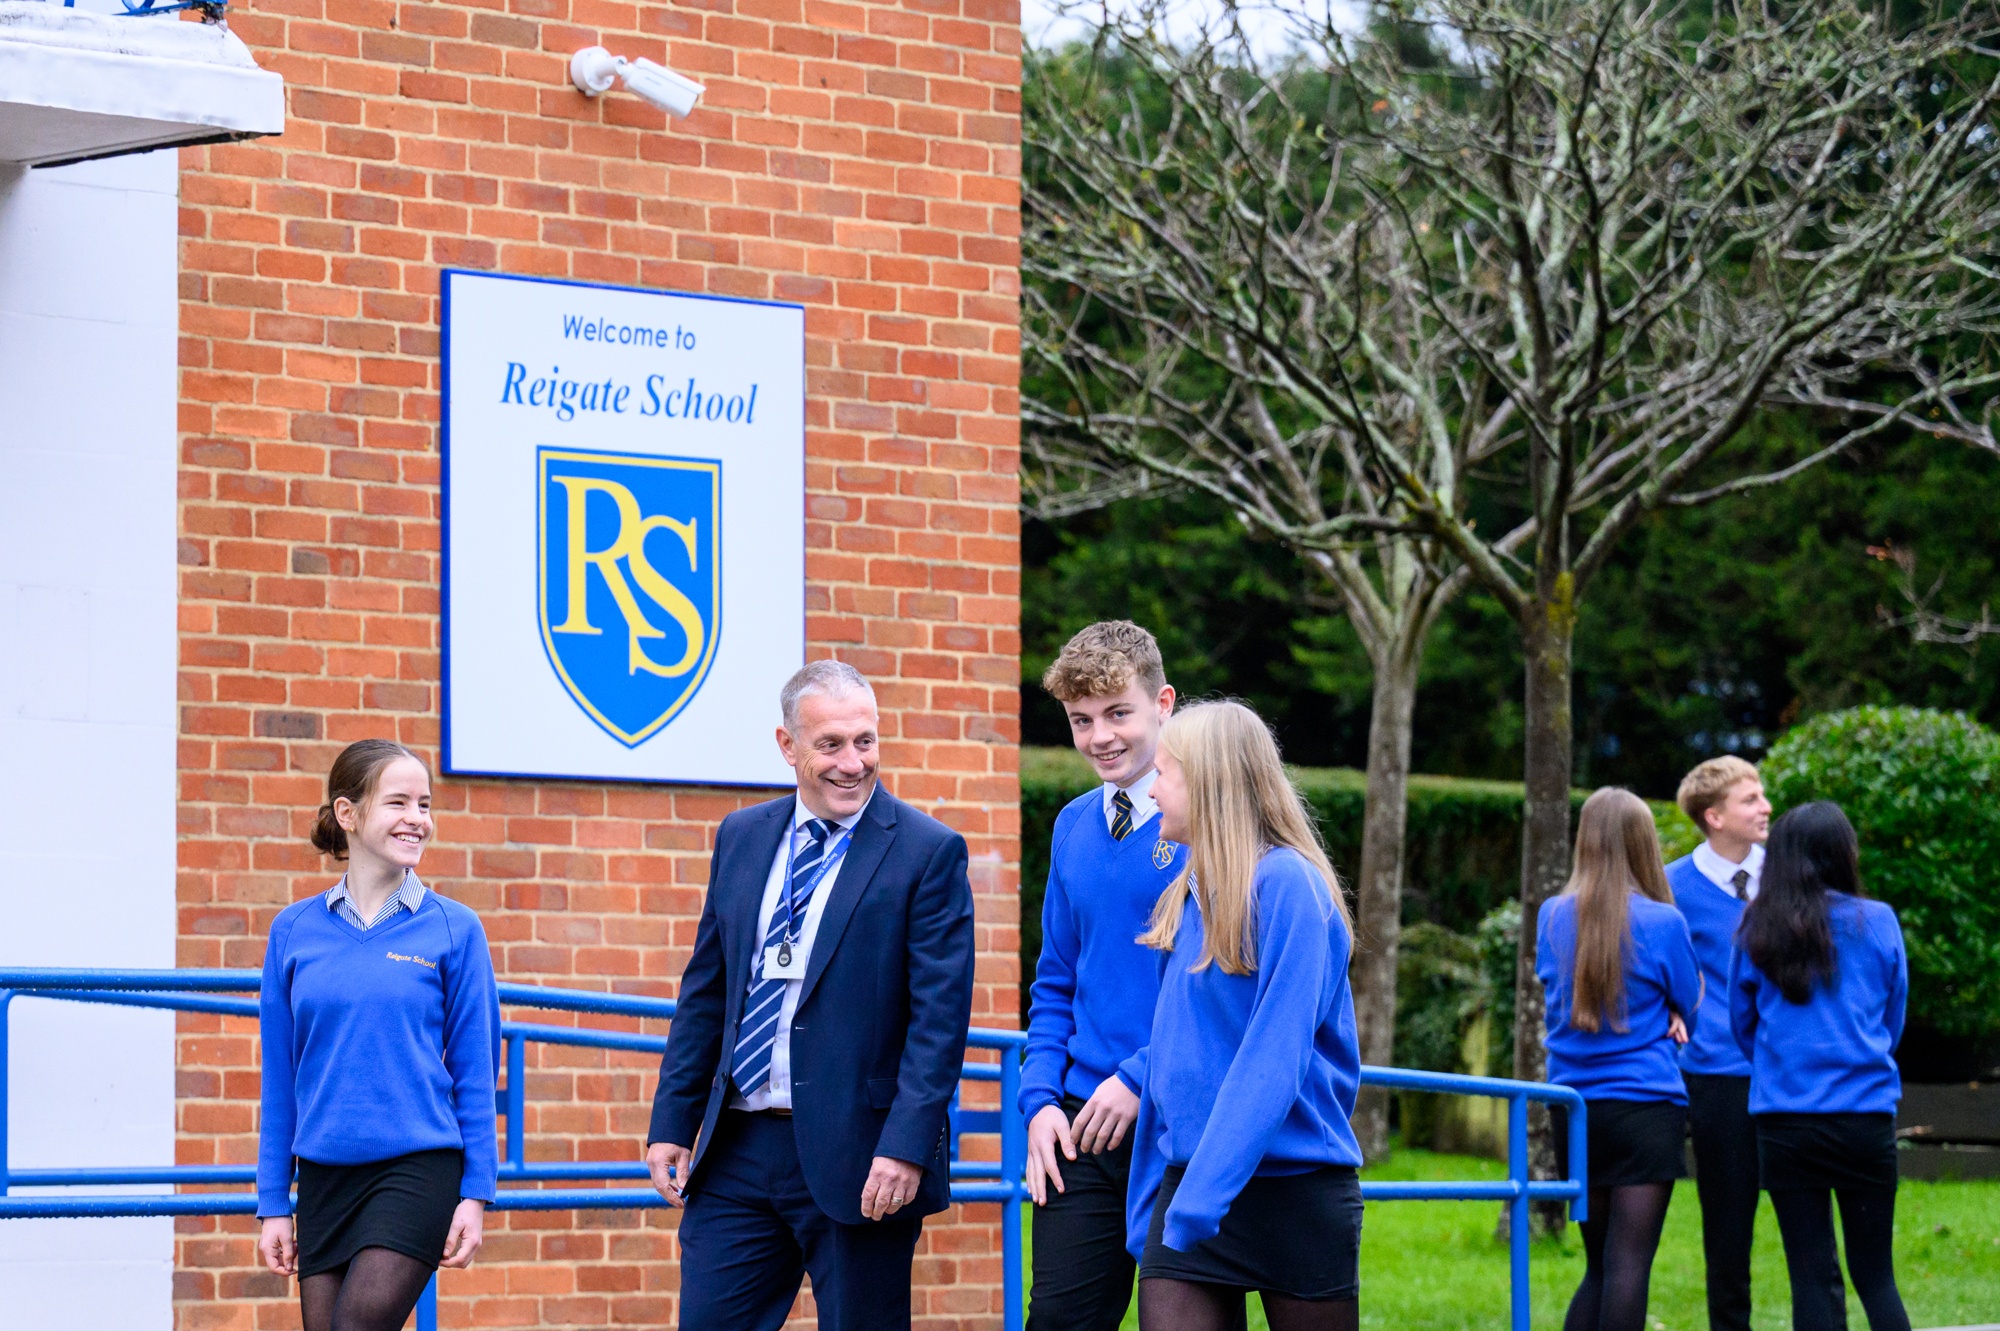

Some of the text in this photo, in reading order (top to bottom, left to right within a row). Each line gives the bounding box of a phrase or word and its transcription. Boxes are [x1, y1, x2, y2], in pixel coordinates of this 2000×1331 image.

[563, 314, 696, 350] Welcome to
[500, 361, 758, 424] Reigate School
[551, 474, 704, 678] RS
[1153, 840, 1174, 862] RS
[412, 956, 436, 969] School
